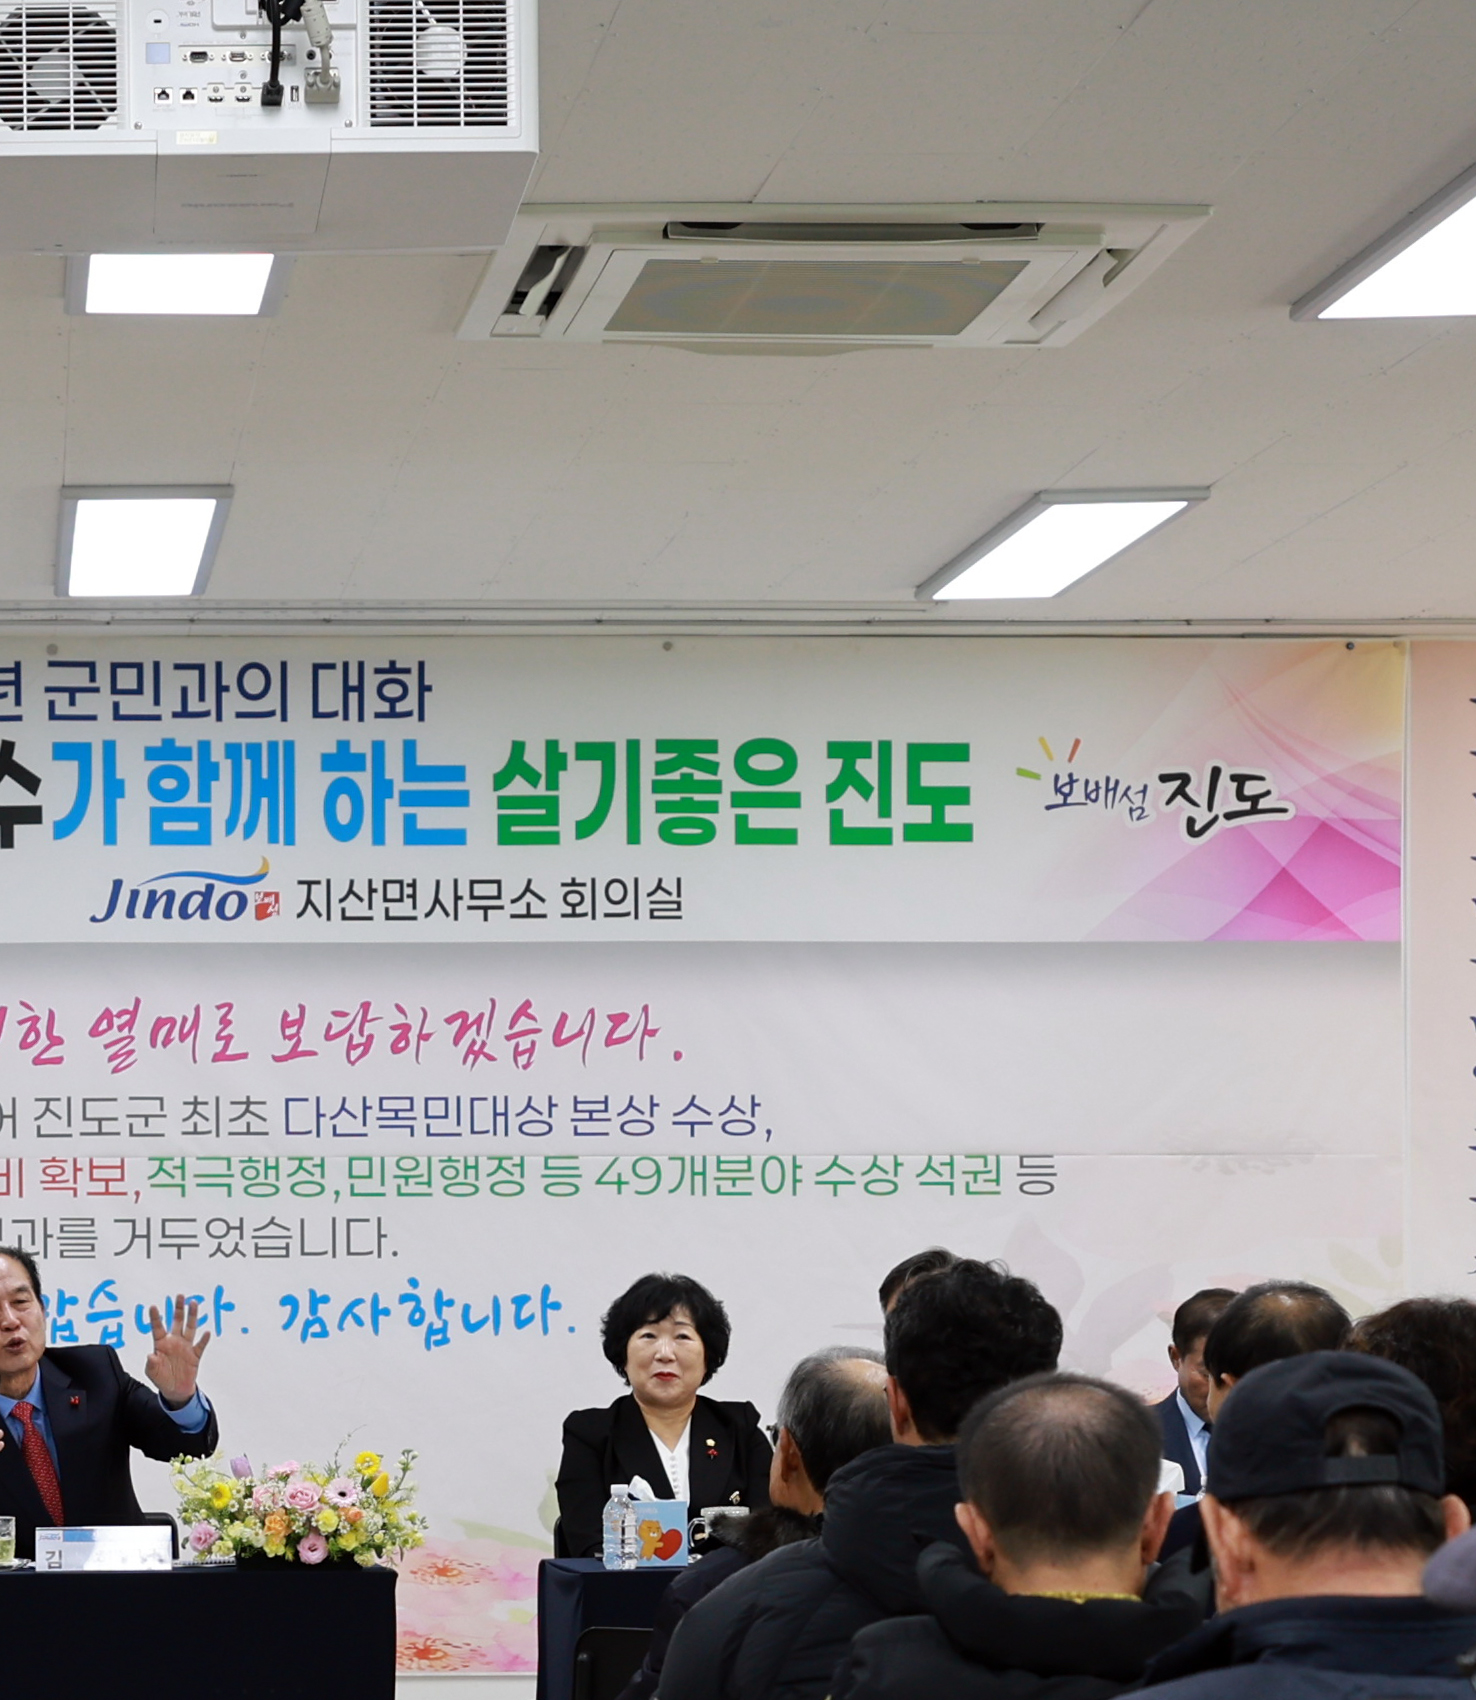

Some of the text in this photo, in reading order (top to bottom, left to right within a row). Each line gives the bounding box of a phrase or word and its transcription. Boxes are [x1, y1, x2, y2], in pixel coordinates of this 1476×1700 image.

[44, 659, 288, 722] 군민과의
[312, 660, 432, 722] 대화
[144, 738, 295, 846] 함께
[321, 739, 470, 846] 하는
[493, 738, 801, 846] 살기좋은
[826, 740, 973, 846] 진도
[1162, 765, 1292, 836] 진도
[86, 878, 249, 926] Jindo
[297, 877, 682, 922] 지산면사무소 회의실
[88, 997, 249, 1074] 열매로
[271, 998, 682, 1070] 보답하겠습니다.
[34, 1096, 167, 1138] 진도군
[181, 1096, 269, 1138] 최초
[285, 1095, 558, 1138] 다산목민대상
[570, 1095, 660, 1136] 본상
[672, 1094, 772, 1142] 수상,
[541, 1158, 582, 1197] 등
[595, 1156, 802, 1196] 49개분야
[815, 1156, 904, 1197] 수상
[916, 1156, 1001, 1195] 석권
[1017, 1156, 1057, 1195] 등
[114, 1216, 398, 1260] 거두었습니다.
[41, 1279, 250, 1350] 맙습니다.
[279, 1277, 575, 1351] 감사합니다.
